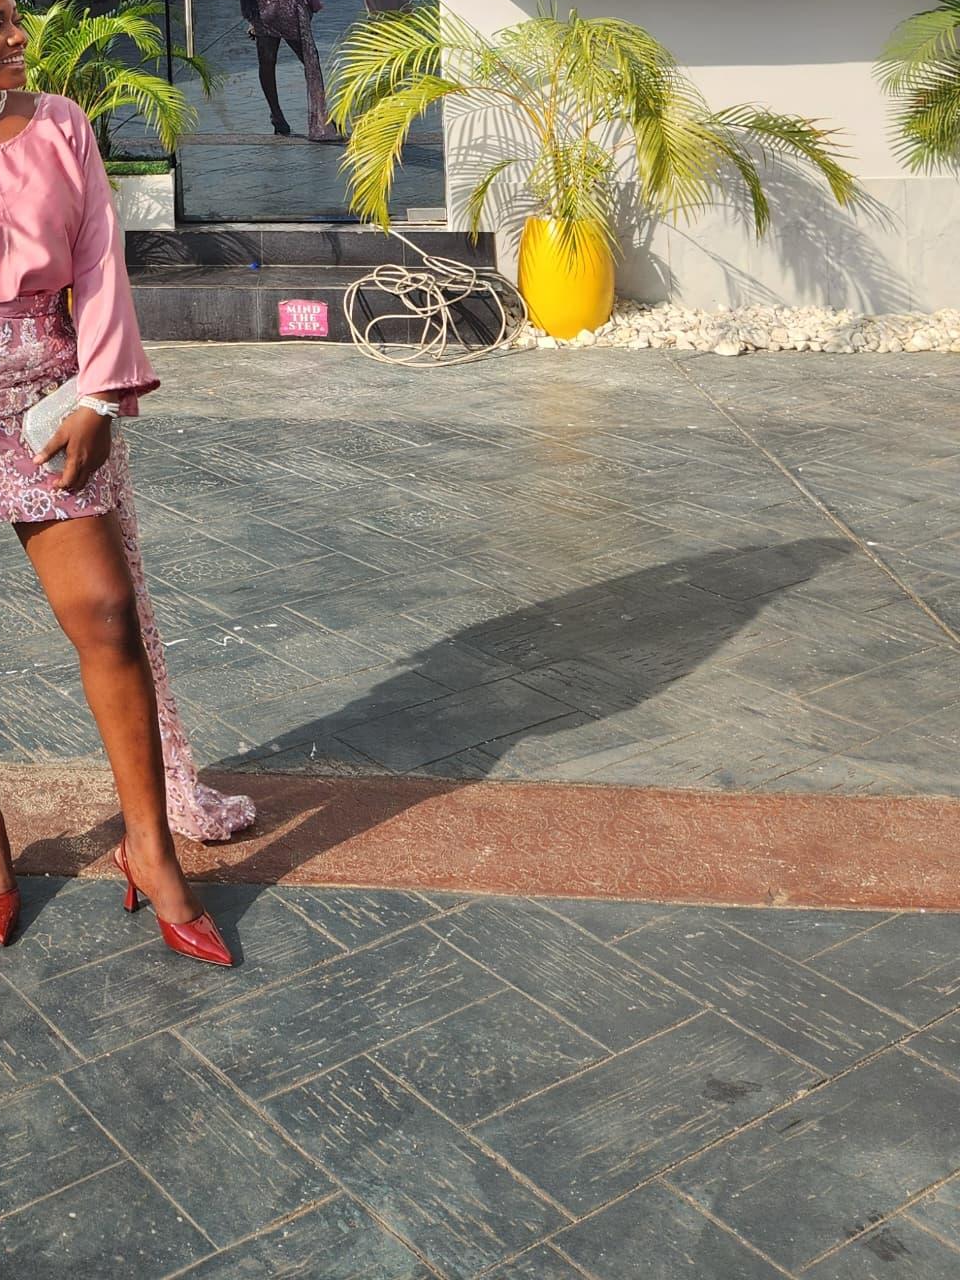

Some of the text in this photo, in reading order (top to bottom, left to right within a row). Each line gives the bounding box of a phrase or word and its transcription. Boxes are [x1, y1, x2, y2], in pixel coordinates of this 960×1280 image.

[286, 305, 320, 313] MIND
[291, 313, 316, 322] THE
[288, 322, 320, 331] STEP
